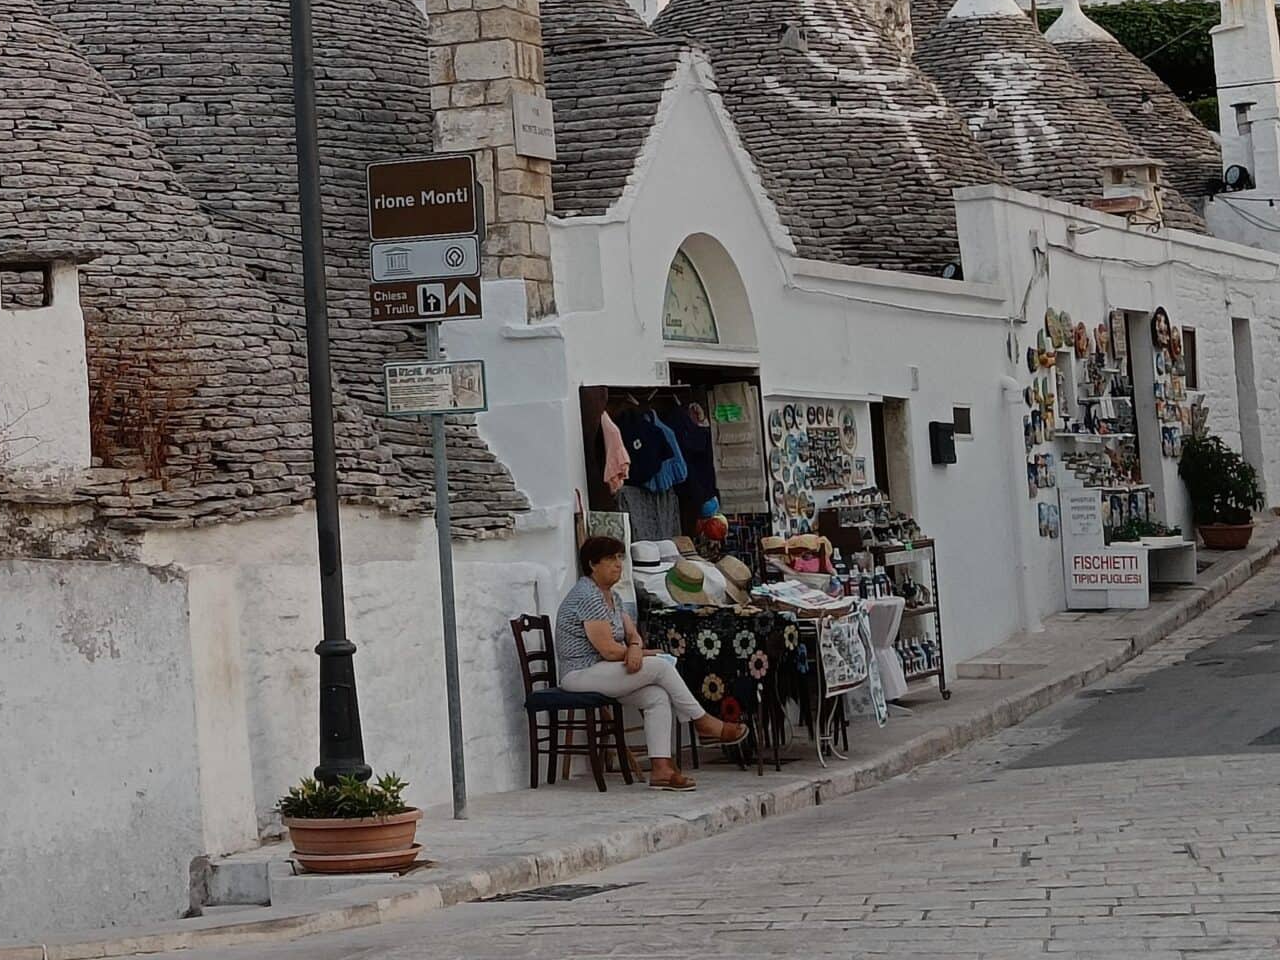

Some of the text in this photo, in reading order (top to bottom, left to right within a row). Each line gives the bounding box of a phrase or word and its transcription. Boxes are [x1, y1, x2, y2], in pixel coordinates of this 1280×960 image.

[374, 187, 468, 209] rione Monti
[373, 290, 408, 302] Chiesa
[373, 303, 416, 315] a Trullo
[1073, 555, 1139, 570] FISCHIETTI
[1072, 574, 1142, 585] TIPICI PUGLIESI
